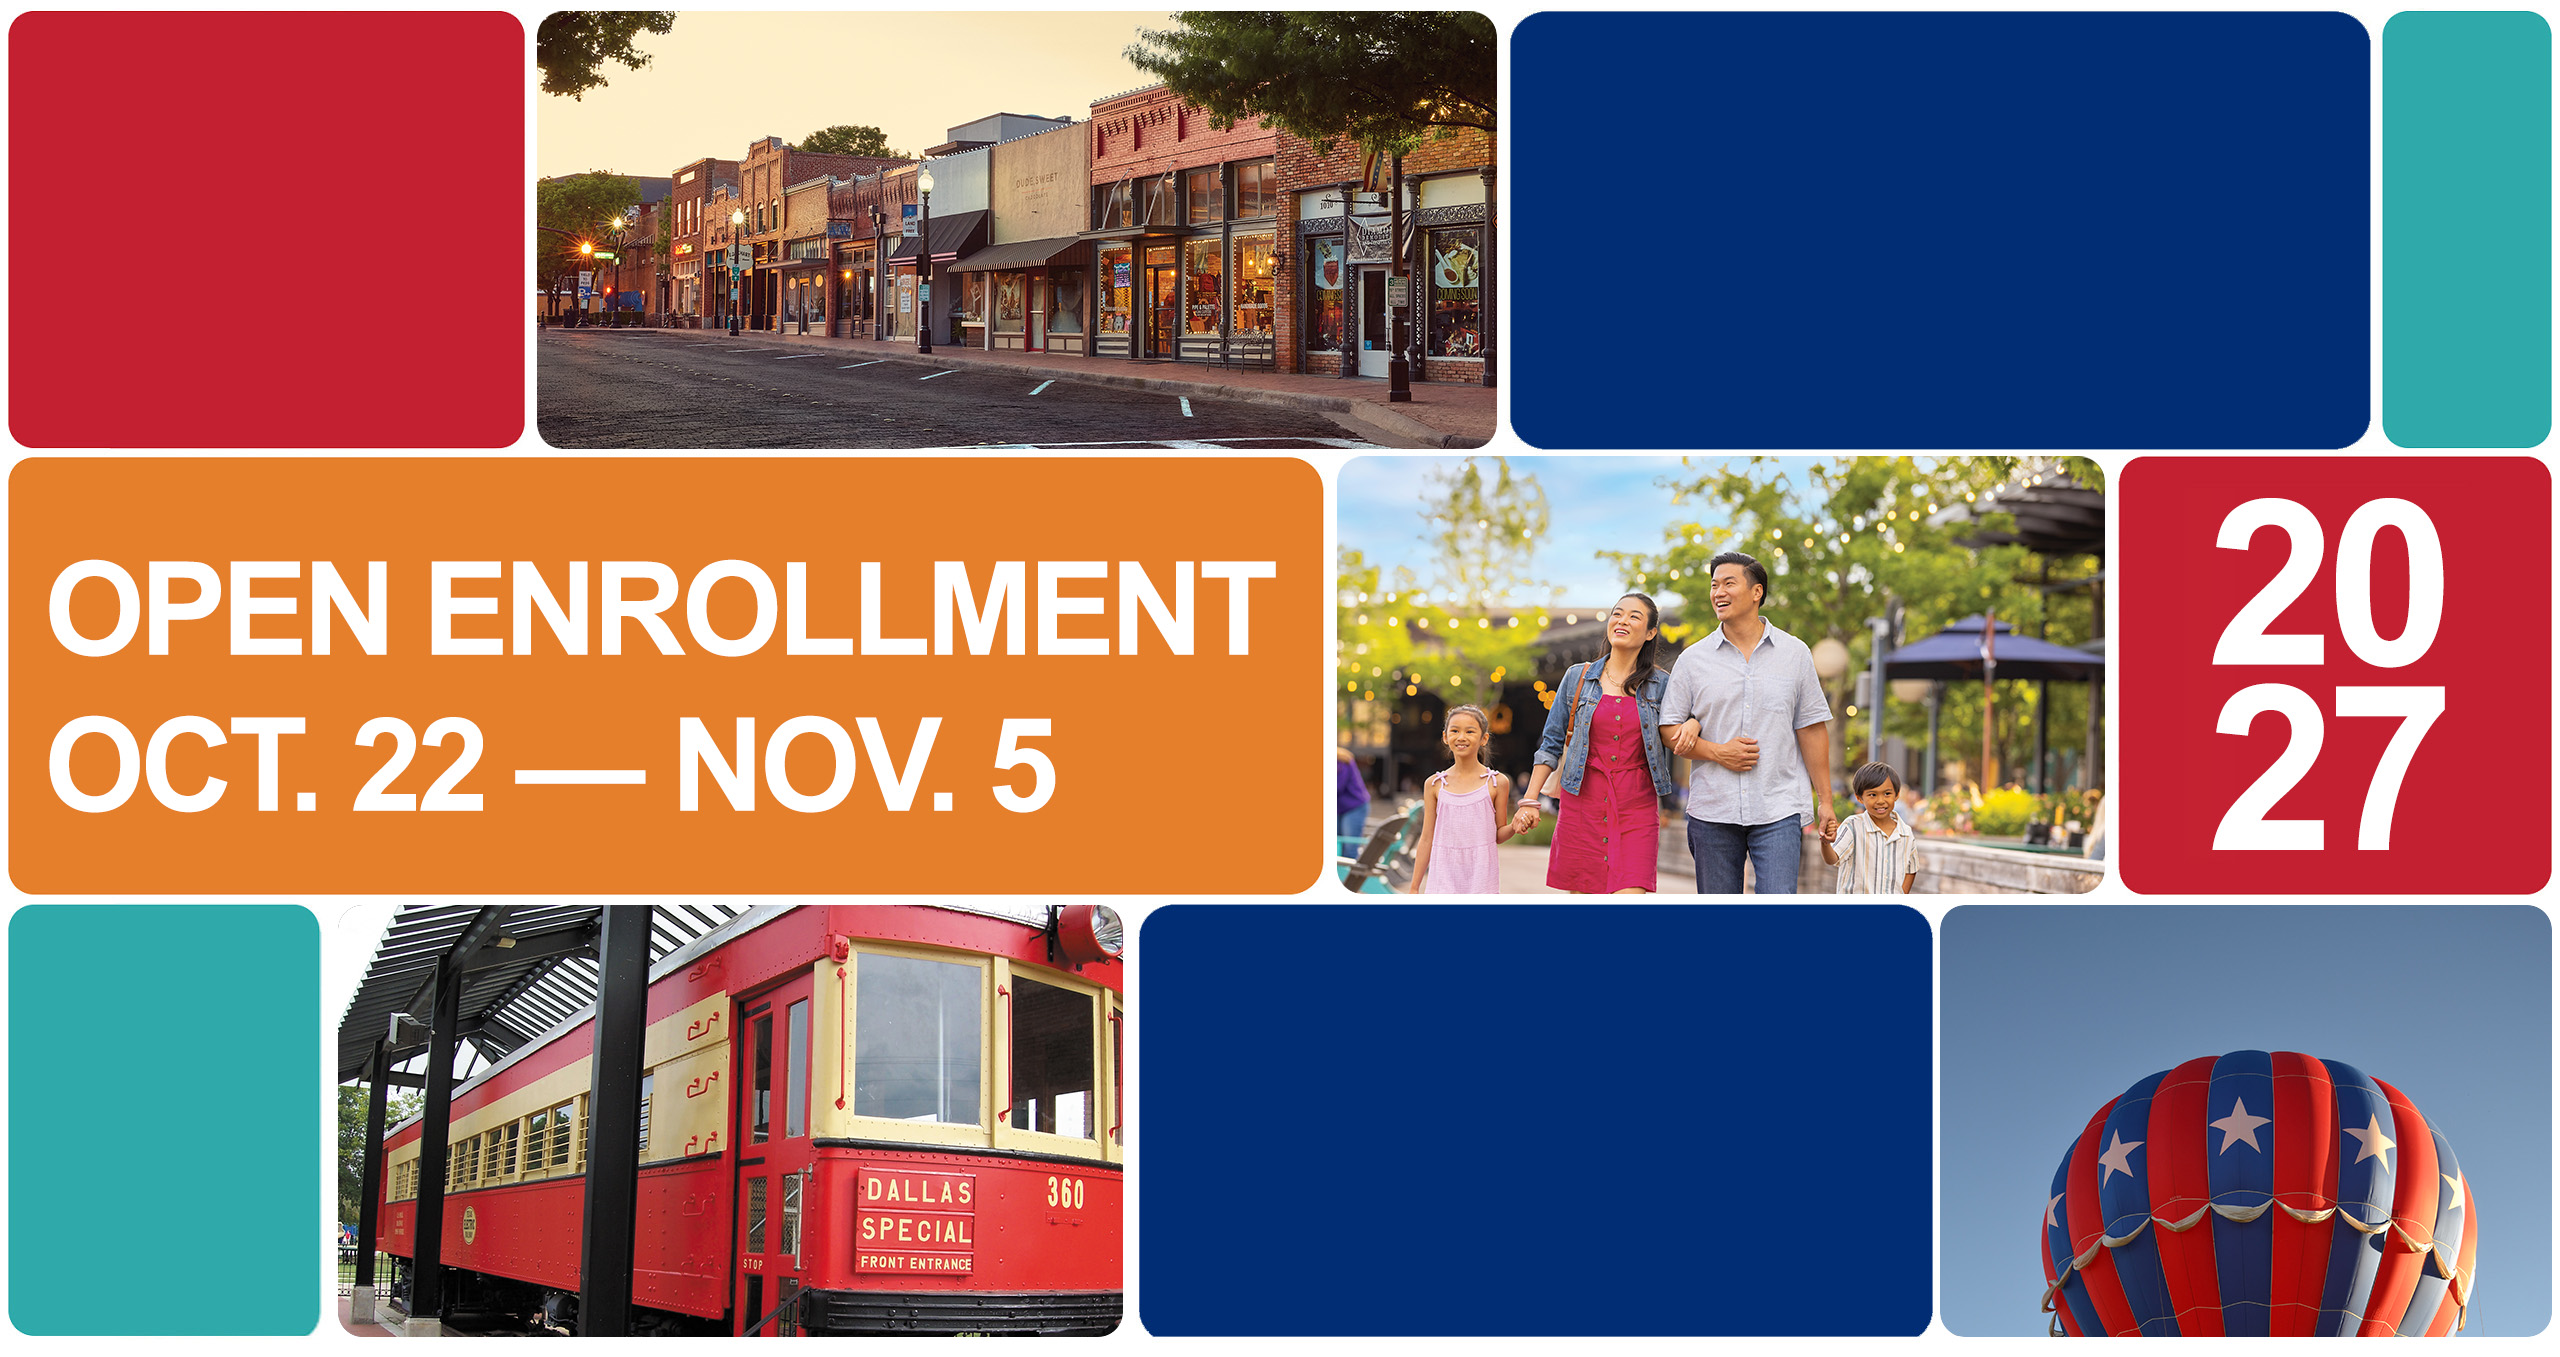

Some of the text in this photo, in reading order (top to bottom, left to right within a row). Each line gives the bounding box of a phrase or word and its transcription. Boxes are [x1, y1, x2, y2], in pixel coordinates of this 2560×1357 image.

[1015, 172, 1058, 189] DUDE SWEET
[1437, 288, 1478, 300] COMING SOON
[867, 1177, 971, 1204] DALLAS
[1047, 1176, 1084, 1209] 360
[862, 1217, 972, 1243] SPECIAL
[743, 1258, 763, 1270] STOP
[861, 1256, 972, 1271] FRONT ENTRANCE
